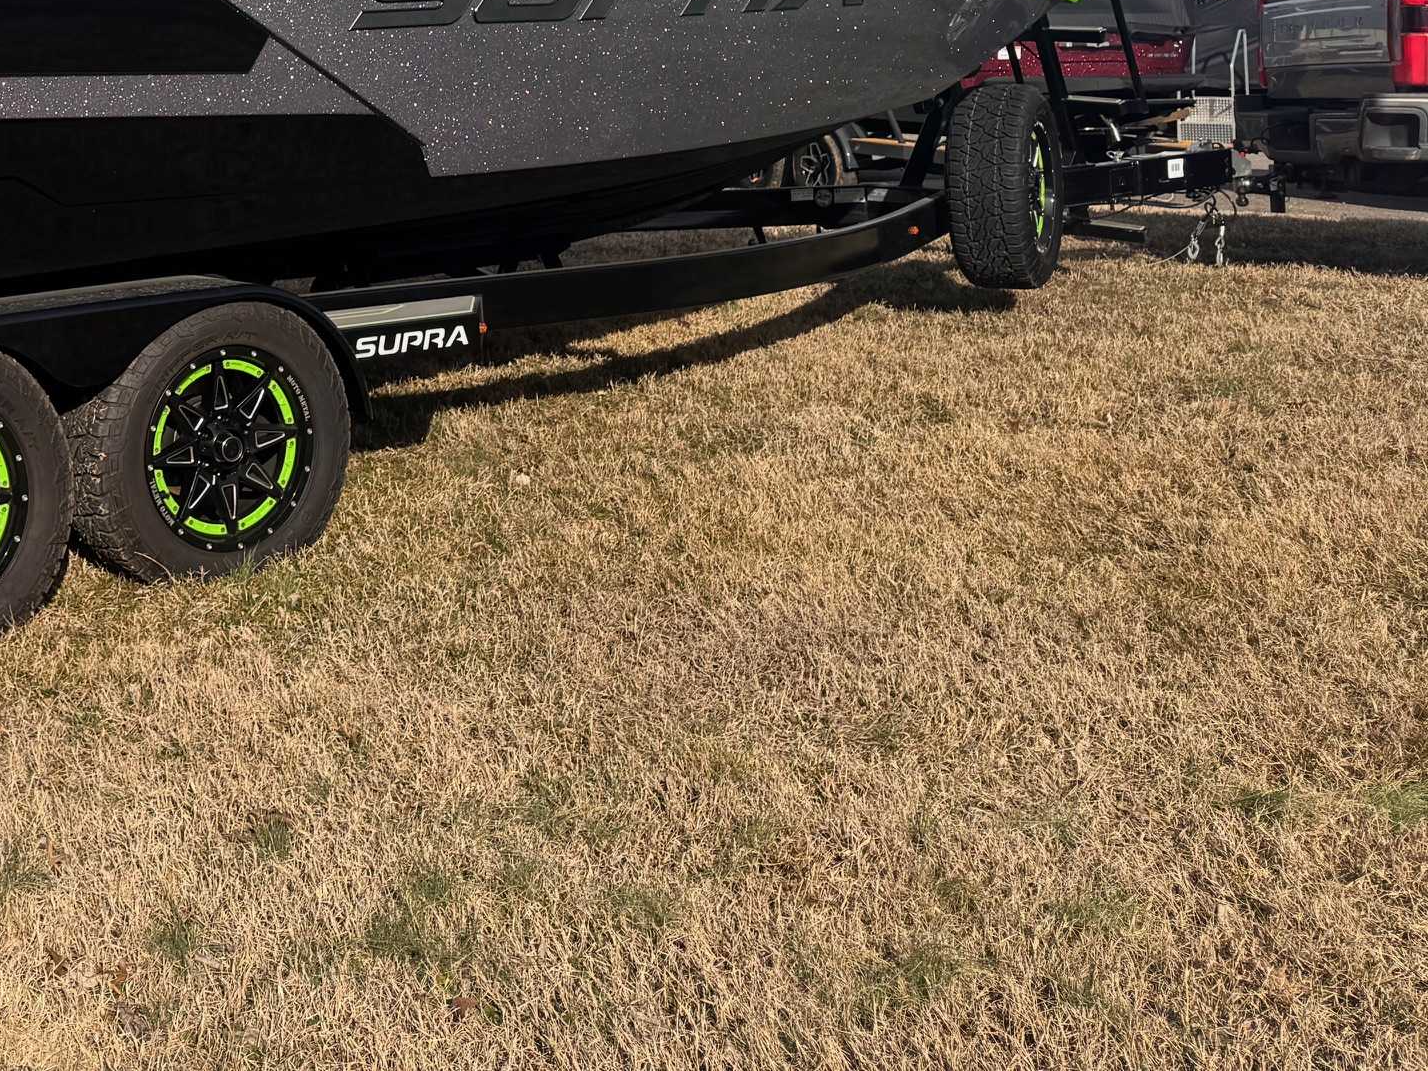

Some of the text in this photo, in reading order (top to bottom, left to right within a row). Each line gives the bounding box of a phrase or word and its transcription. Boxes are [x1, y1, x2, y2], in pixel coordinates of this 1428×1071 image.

[355, 325, 469, 359] SUPRA
[286, 375, 311, 422] MOTO METAL
[149, 478, 176, 526] MOTO METAL
